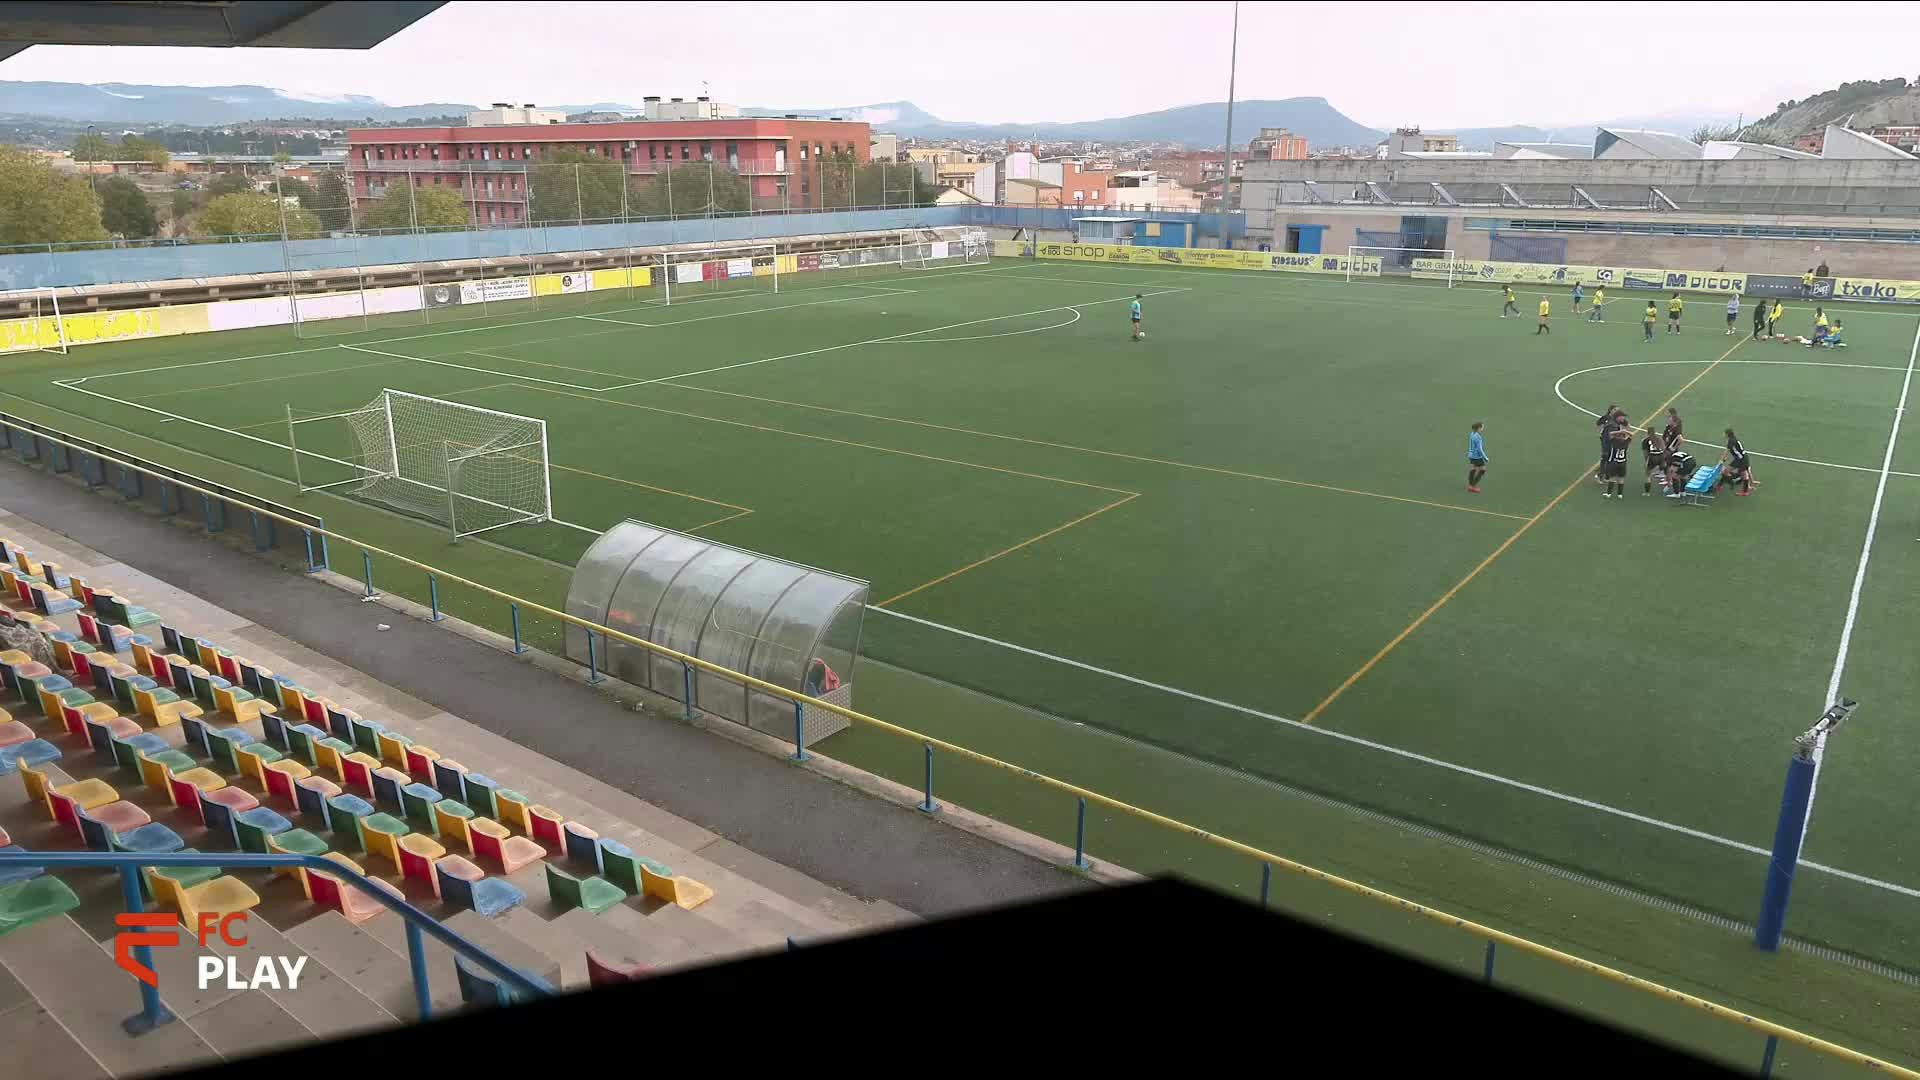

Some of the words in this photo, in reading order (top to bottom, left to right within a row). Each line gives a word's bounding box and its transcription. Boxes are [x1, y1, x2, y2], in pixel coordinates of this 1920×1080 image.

[1272, 256, 1310, 266] KIDS&US
[1416, 261, 1432, 270] BAR
[1434, 262, 1474, 271] GRANADA
[1691, 277, 1742, 290] DICOR
